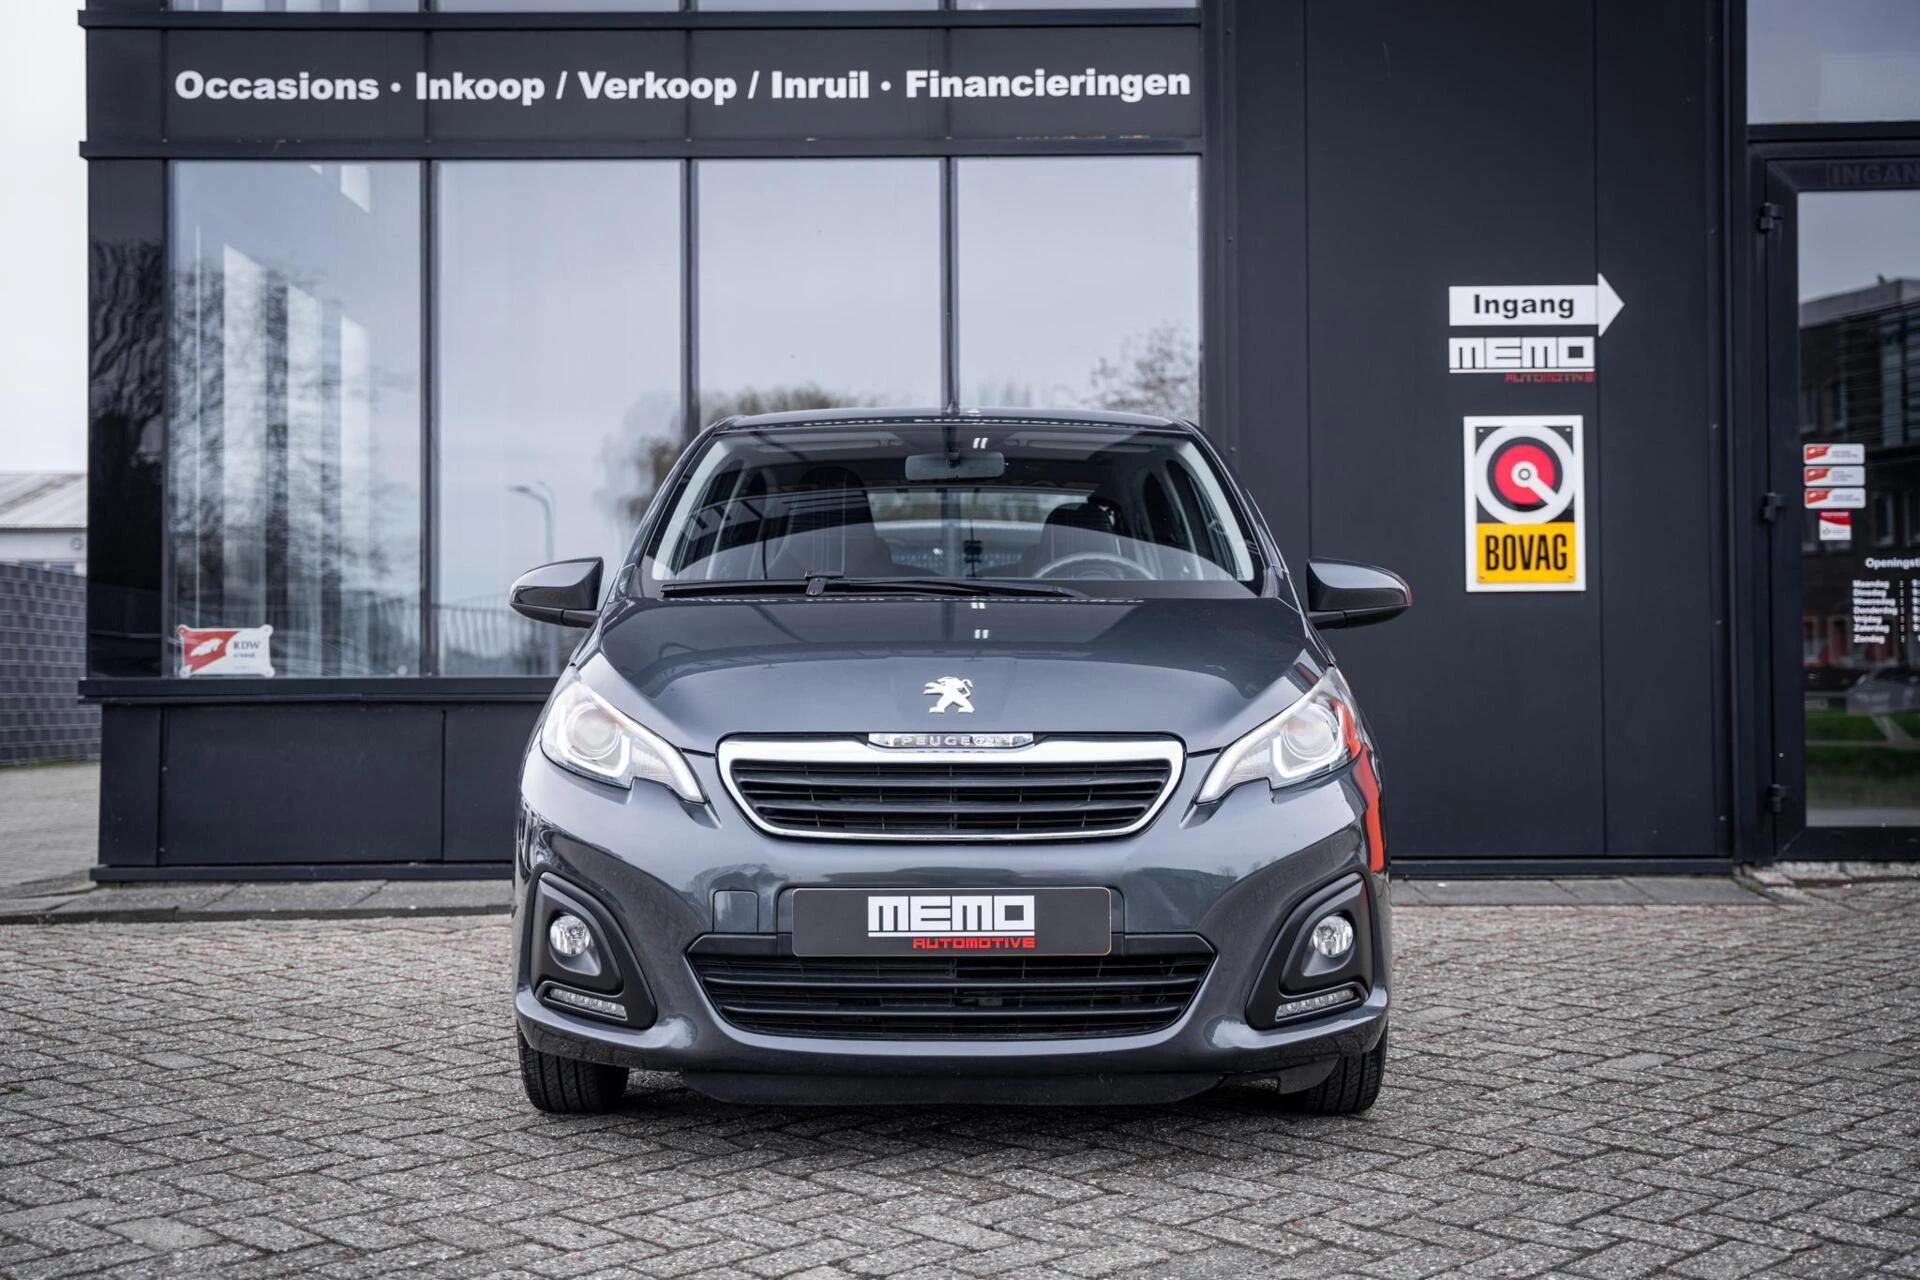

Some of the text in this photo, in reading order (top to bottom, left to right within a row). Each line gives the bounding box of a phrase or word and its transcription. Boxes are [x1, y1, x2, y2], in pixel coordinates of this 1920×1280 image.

[176, 71, 380, 99] Occasions
[417, 72, 545, 105] Inkoop
[578, 72, 737, 105] Verkoop
[772, 71, 868, 98] Inruil
[907, 68, 1190, 102] Financieringen
[1474, 294, 1574, 319] Ingang
[1449, 337, 1594, 368] MEMO
[1485, 534, 1567, 571] BOVAG
[868, 896, 1035, 931] MEMO
[912, 937, 1035, 949] AUTOMOTIVE
